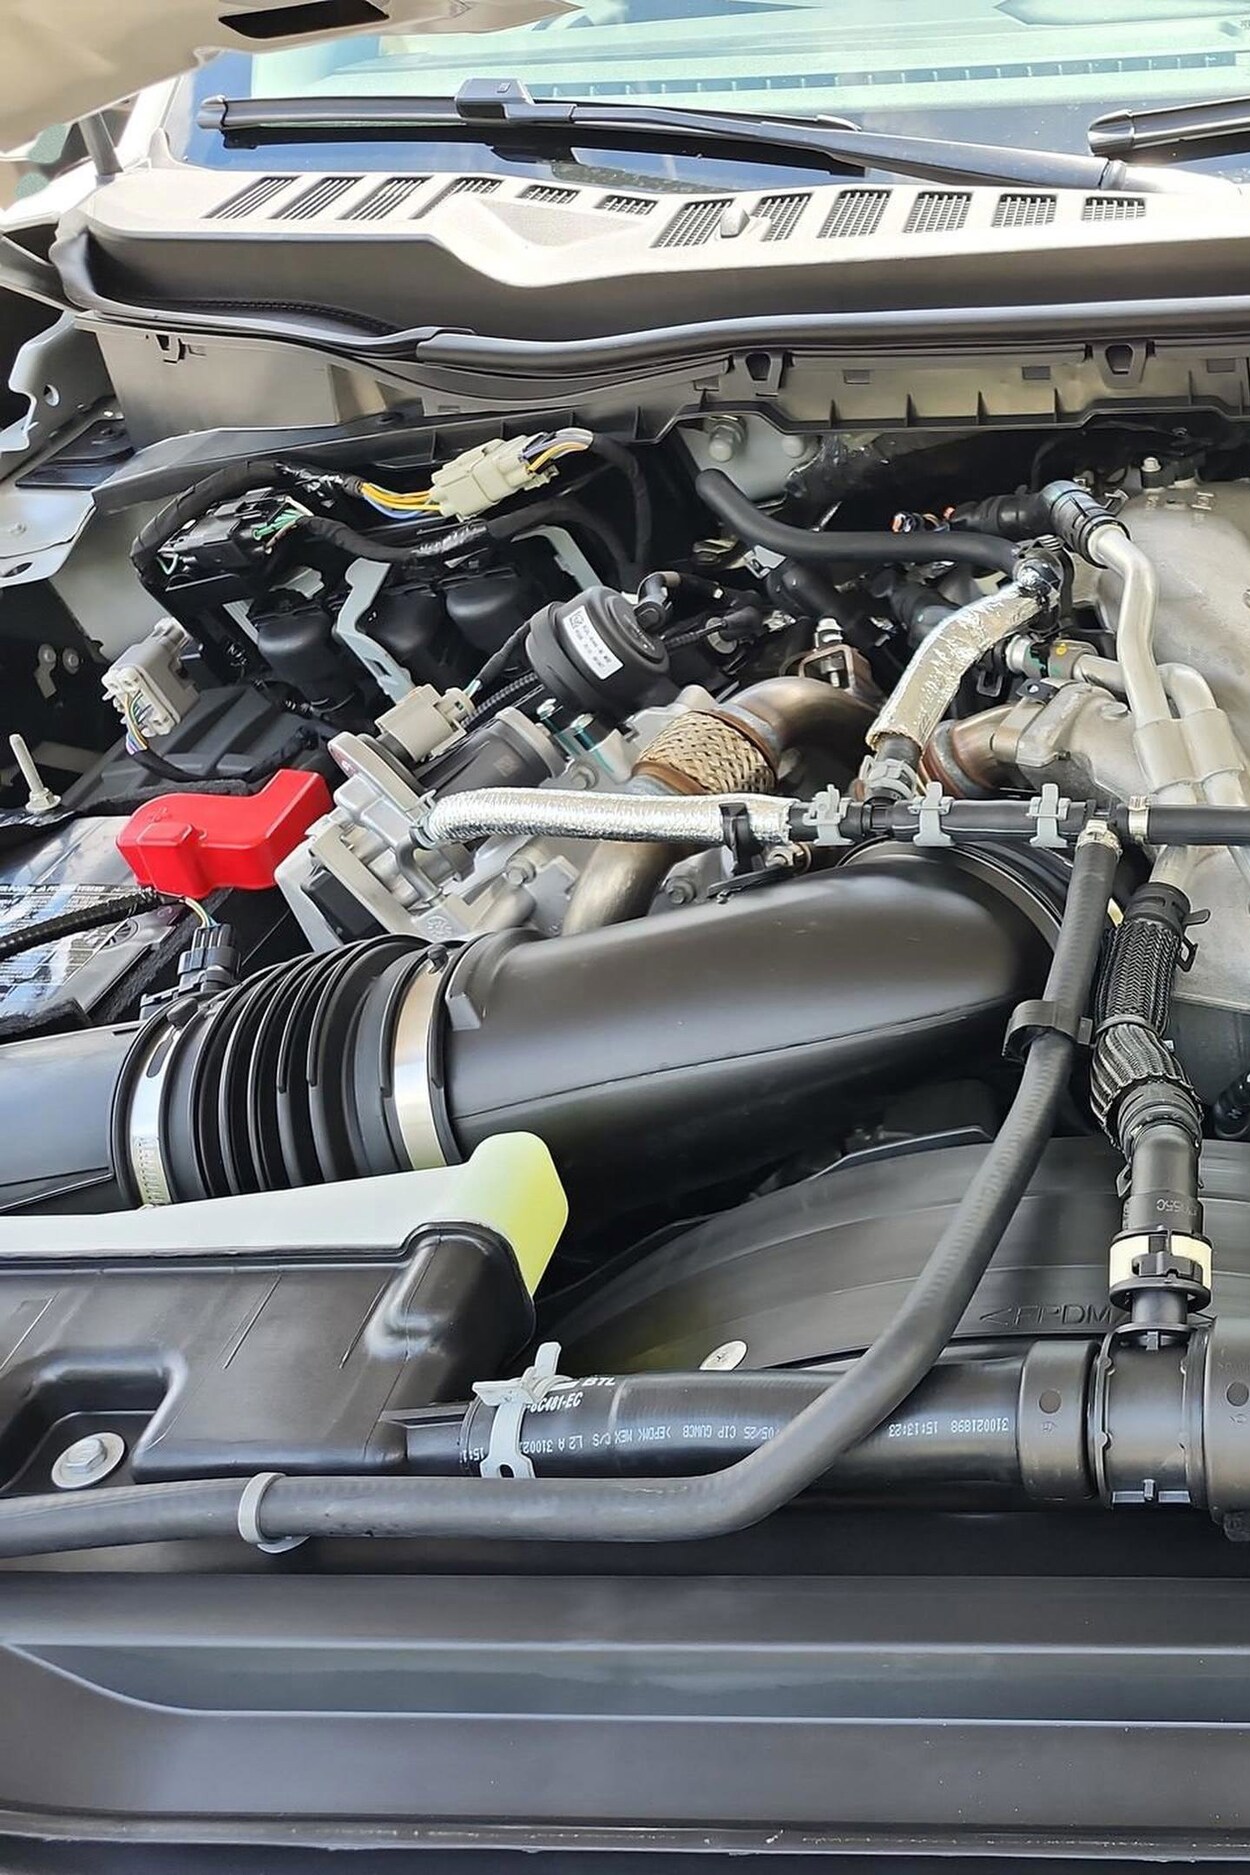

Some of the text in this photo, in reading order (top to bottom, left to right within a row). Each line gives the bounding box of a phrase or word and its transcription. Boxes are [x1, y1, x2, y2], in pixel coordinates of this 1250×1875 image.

[582, 1376, 616, 1387] BTL
[717, 1425, 736, 1439] CIP
[744, 1425, 778, 1440] 05/25
[888, 1416, 1010, 1438] 310021898 15:13:23
[520, 1440, 554, 1455] 31002
